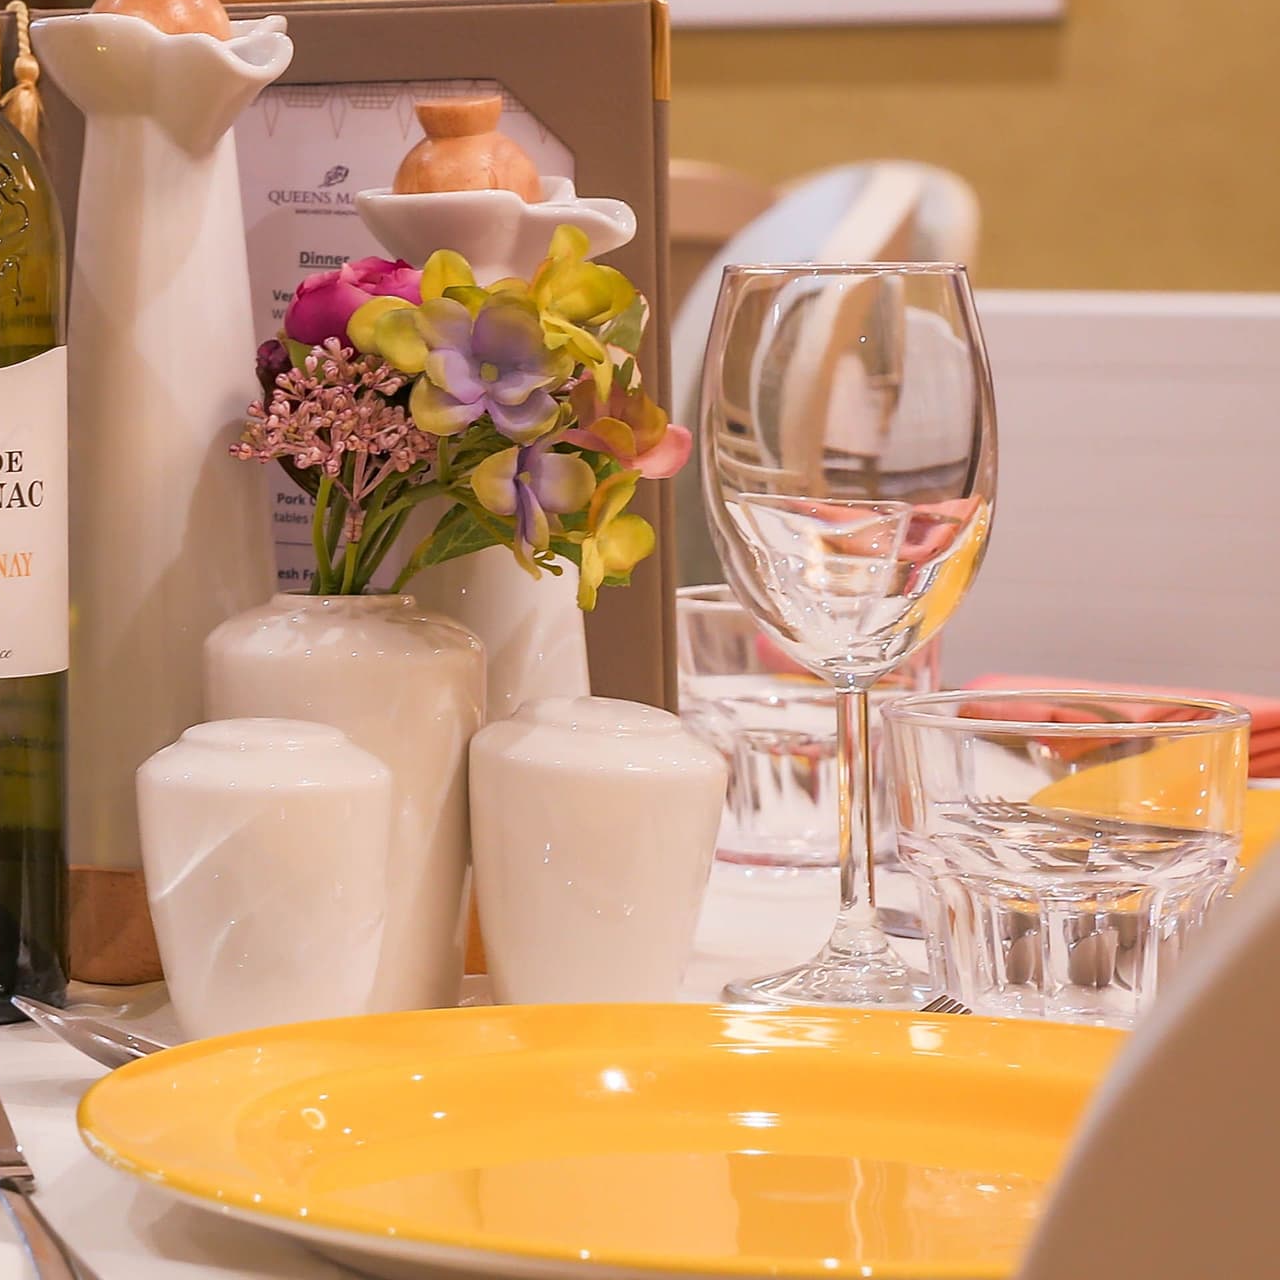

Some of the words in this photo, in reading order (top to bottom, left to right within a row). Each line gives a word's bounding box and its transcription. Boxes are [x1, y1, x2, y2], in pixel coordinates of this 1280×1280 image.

[268, 190, 331, 205] QUEENS
[299, 251, 351, 268] Dinner
[277, 493, 305, 505] Pork
